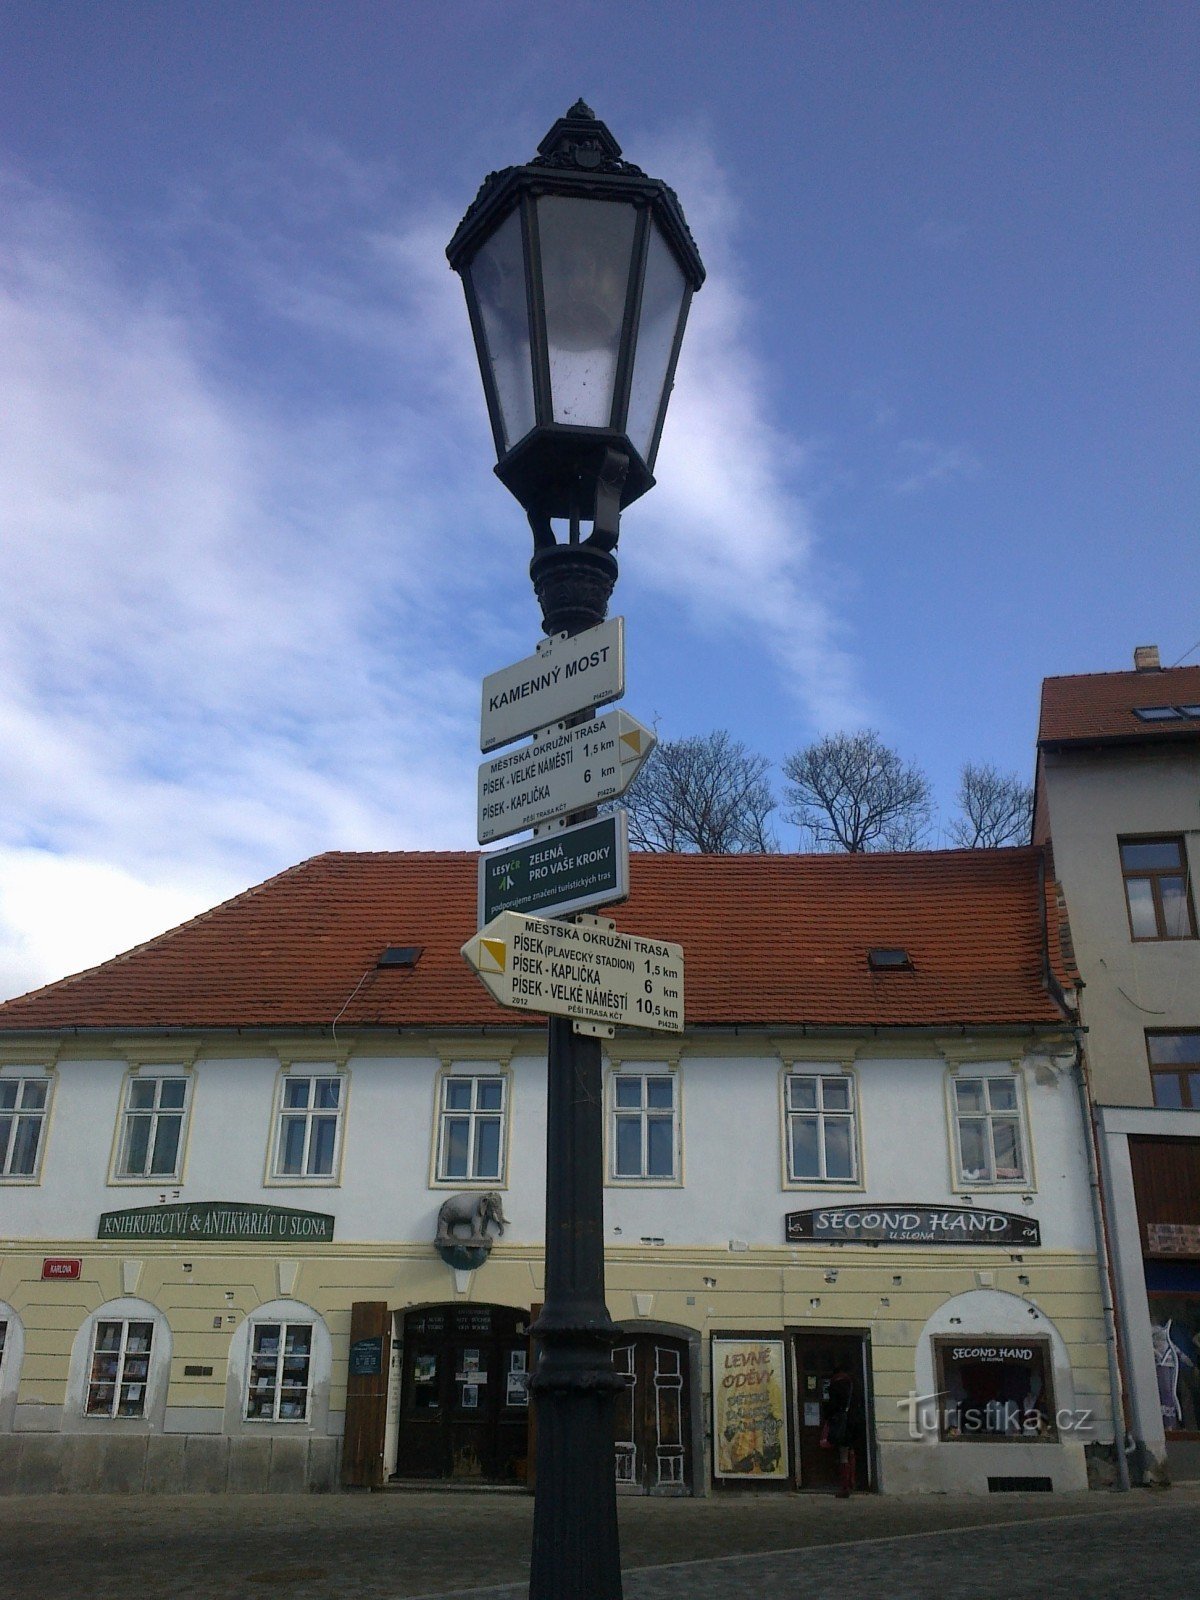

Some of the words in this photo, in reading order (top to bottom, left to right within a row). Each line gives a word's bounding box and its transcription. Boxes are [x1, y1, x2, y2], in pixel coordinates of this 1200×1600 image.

[489, 665, 561, 712] KAMENNÝ
[565, 646, 610, 679] MOST
[490, 749, 531, 774] MĚSTSKÁ
[533, 732, 573, 757] OKRUŽNÍ
[574, 720, 607, 740] TRASA
[483, 776, 505, 796] PÍSEK
[511, 762, 536, 786] VELKÉ
[537, 747, 573, 775] NÁMĚSTÍ
[583, 743, 599, 757] 1,5
[600, 740, 615, 752] km
[482, 801, 505, 821] PÍSEK
[510, 784, 551, 811] KAPLIČKA
[583, 769, 592, 783] 6
[601, 766, 615, 778] km
[536, 808, 554, 818] TRASA
[555, 803, 567, 812] KČT
[529, 843, 564, 867] ZELENÁ
[529, 866, 548, 882] PRO
[550, 856, 574, 875] VAŠE
[576, 846, 611, 868] KROKY
[490, 895, 531, 915] podporujeme
[533, 887, 557, 901] značení
[558, 874, 597, 893] turistických
[598, 871, 611, 882] tras
[525, 920, 580, 941] MĚSTSKÁ
[583, 932, 632, 951] OKRUŽNÍ
[634, 941, 670, 958] TRASA
[513, 932, 544, 955] PÍSEK
[595, 954, 635, 974] STADION)
[644, 960, 661, 976] 1,5
[663, 966, 678, 979] km
[512, 953, 543, 976] PÍSEK
[551, 962, 601, 985] KAPLIČKA
[644, 979, 653, 994] 6
[663, 986, 678, 998] km
[512, 974, 542, 997] PÍSEK
[550, 983, 583, 1003] VELKÉ
[586, 987, 628, 1011] NÁMĚSTÍ
[636, 997, 660, 1016] 10,5
[663, 1006, 678, 1019] km
[512, 996, 528, 1005] 2012
[567, 1005, 584, 1014] PĚŠÍ
[585, 1008, 608, 1018] TRASA
[609, 1012, 623, 1020] KČT
[658, 1020, 679, 1030] PI423b
[104, 1207, 191, 1234] KNIHKUPECTVÍ
[190, 1214, 202, 1231] &
[202, 1208, 276, 1235] ANTIKVARIÁT
[278, 1215, 288, 1235] U
[290, 1216, 327, 1236] SLONA
[815, 1212, 922, 1232] SECOND
[929, 1213, 1009, 1232] HAND
[889, 1231, 898, 1240] U
[900, 1231, 935, 1240] SLONA
[49, 1264, 72, 1274] KARLOVA
[724, 1347, 771, 1369] LEVNÉ
[952, 1347, 997, 1360] SECOND
[999, 1347, 1033, 1360] HAND
[722, 1368, 775, 1388] ODĚVY
